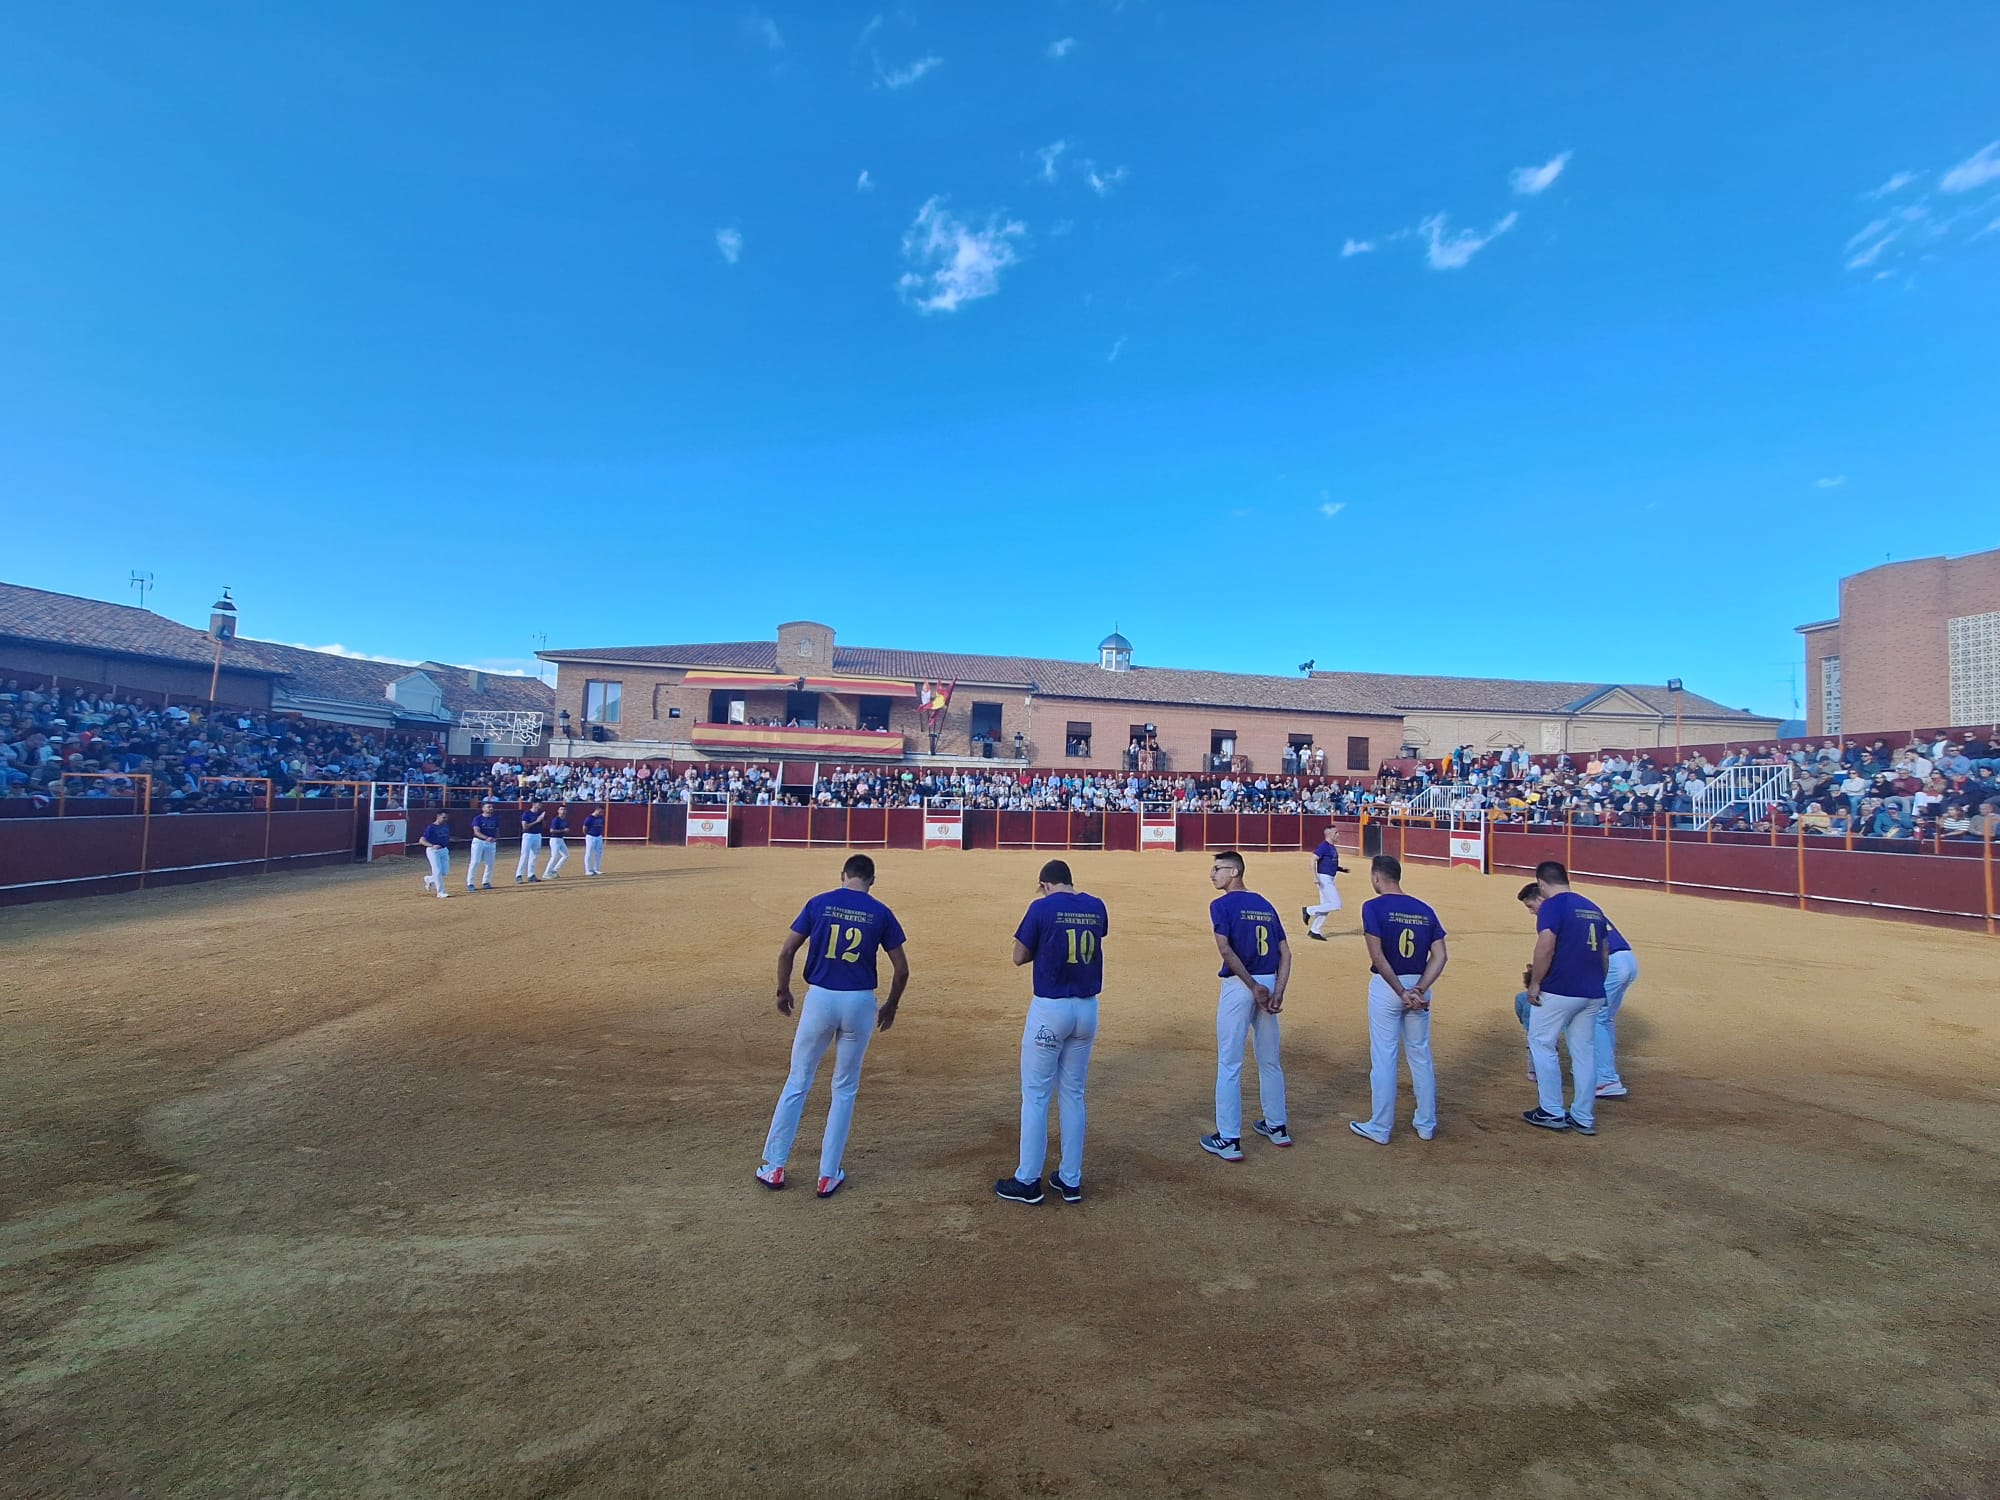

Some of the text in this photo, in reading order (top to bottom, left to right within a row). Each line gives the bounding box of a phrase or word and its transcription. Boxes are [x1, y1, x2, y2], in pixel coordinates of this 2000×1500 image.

[824, 924, 862, 963] 12
[1065, 928, 1095, 965] 10
[1255, 925, 1269, 956] 8
[1398, 928, 1415, 959] 6
[1586, 922, 1598, 952] 4
